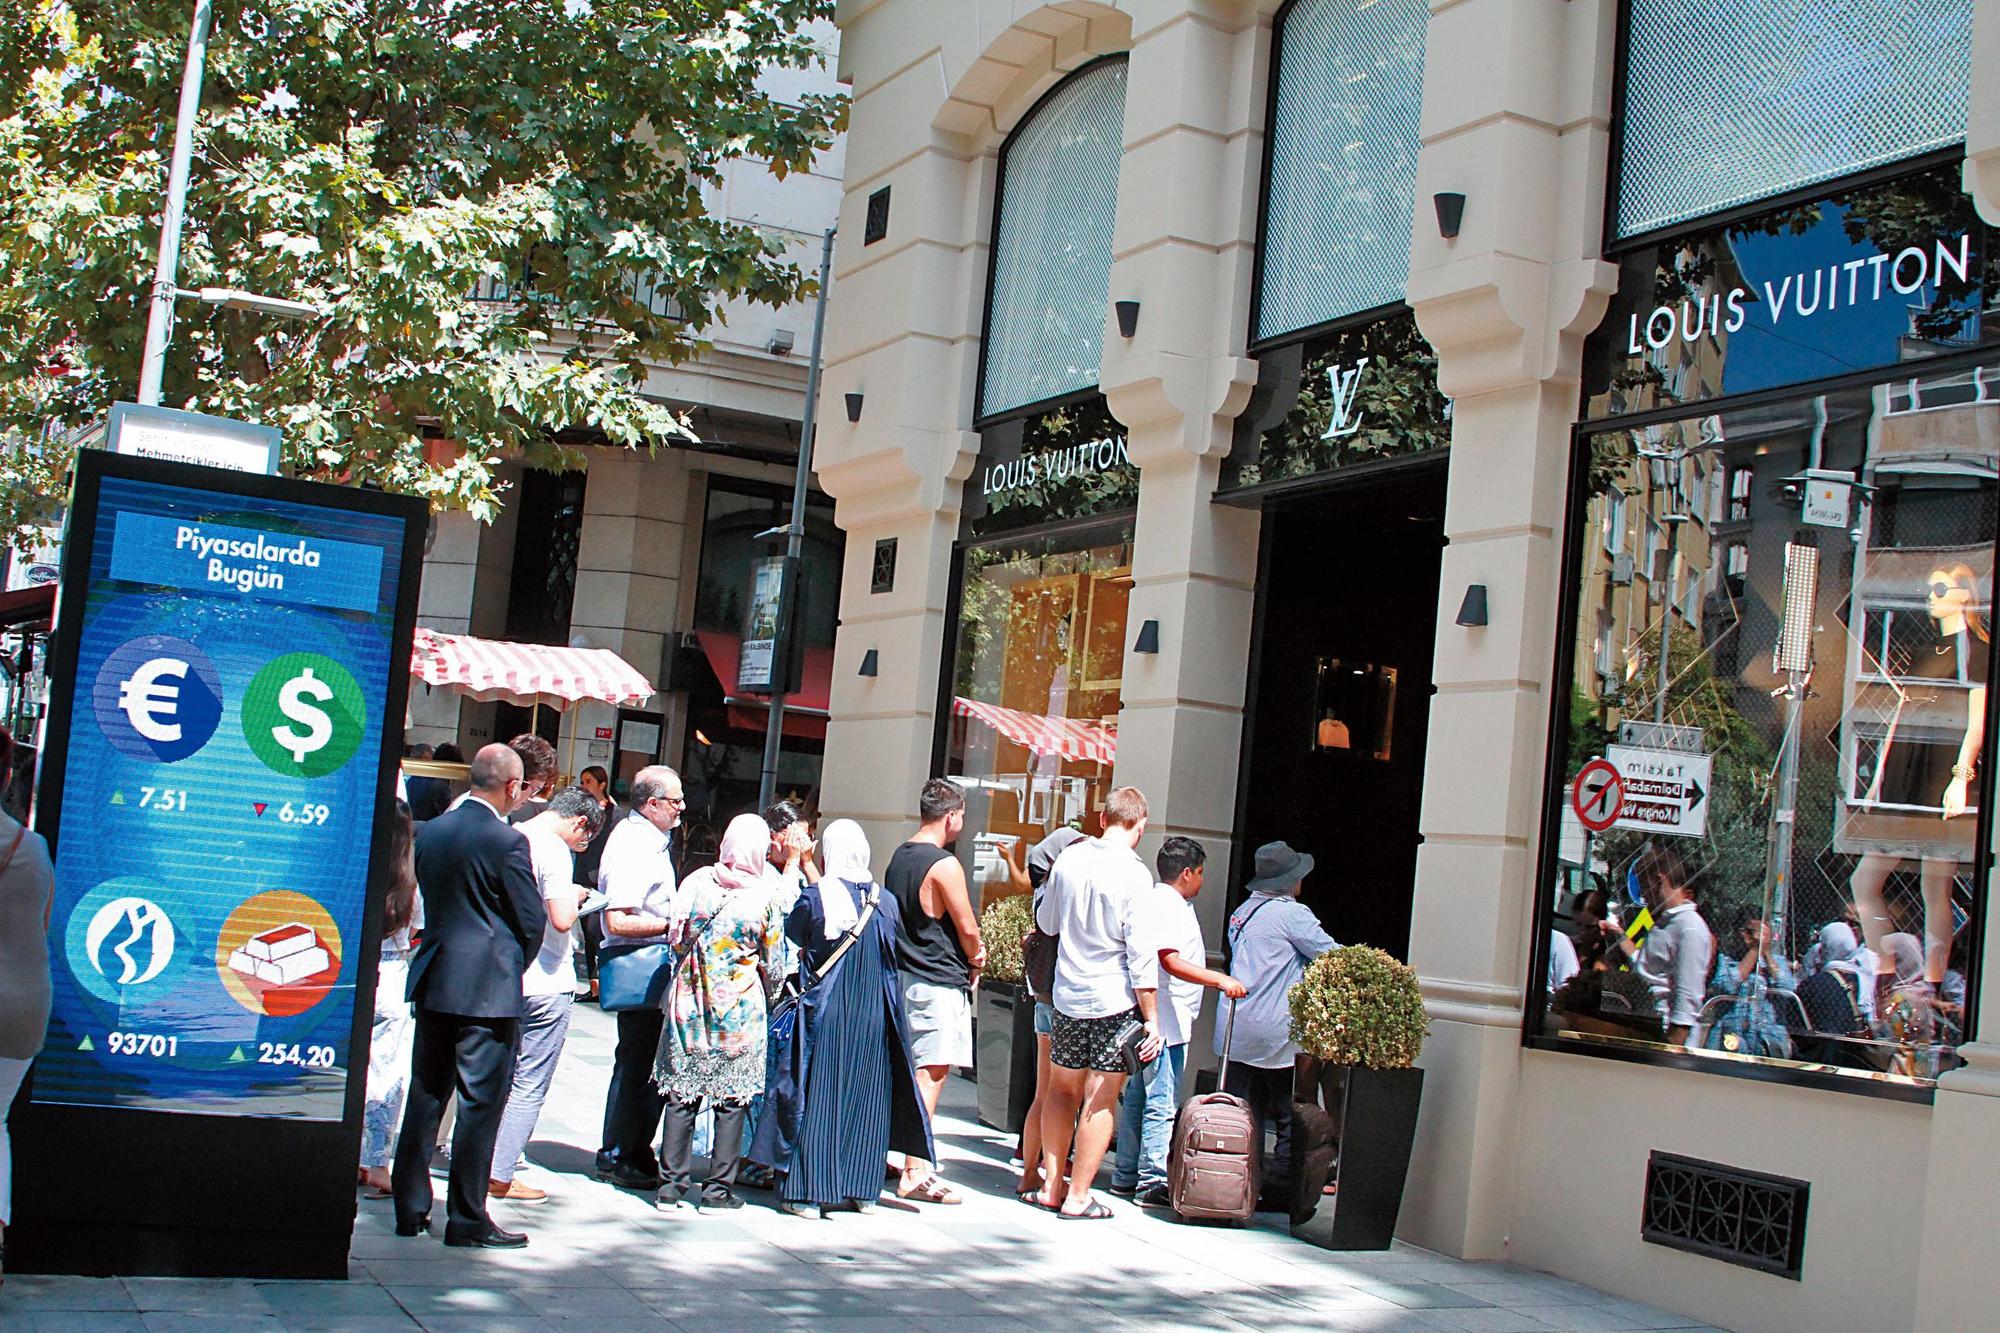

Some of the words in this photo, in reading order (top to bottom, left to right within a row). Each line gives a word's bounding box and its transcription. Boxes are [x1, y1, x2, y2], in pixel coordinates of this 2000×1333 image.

[1627, 288, 1746, 356] LOUIS
[1763, 234, 1970, 326] VUITTON
[983, 454, 1038, 495] LOUIS
[1044, 434, 1130, 482] VUITTON
[175, 525, 320, 568] Piyasalarda
[206, 556, 284, 593] Bugün
[139, 787, 187, 812] 7.51
[278, 801, 330, 826] 6.59
[107, 1031, 178, 1058] 93701
